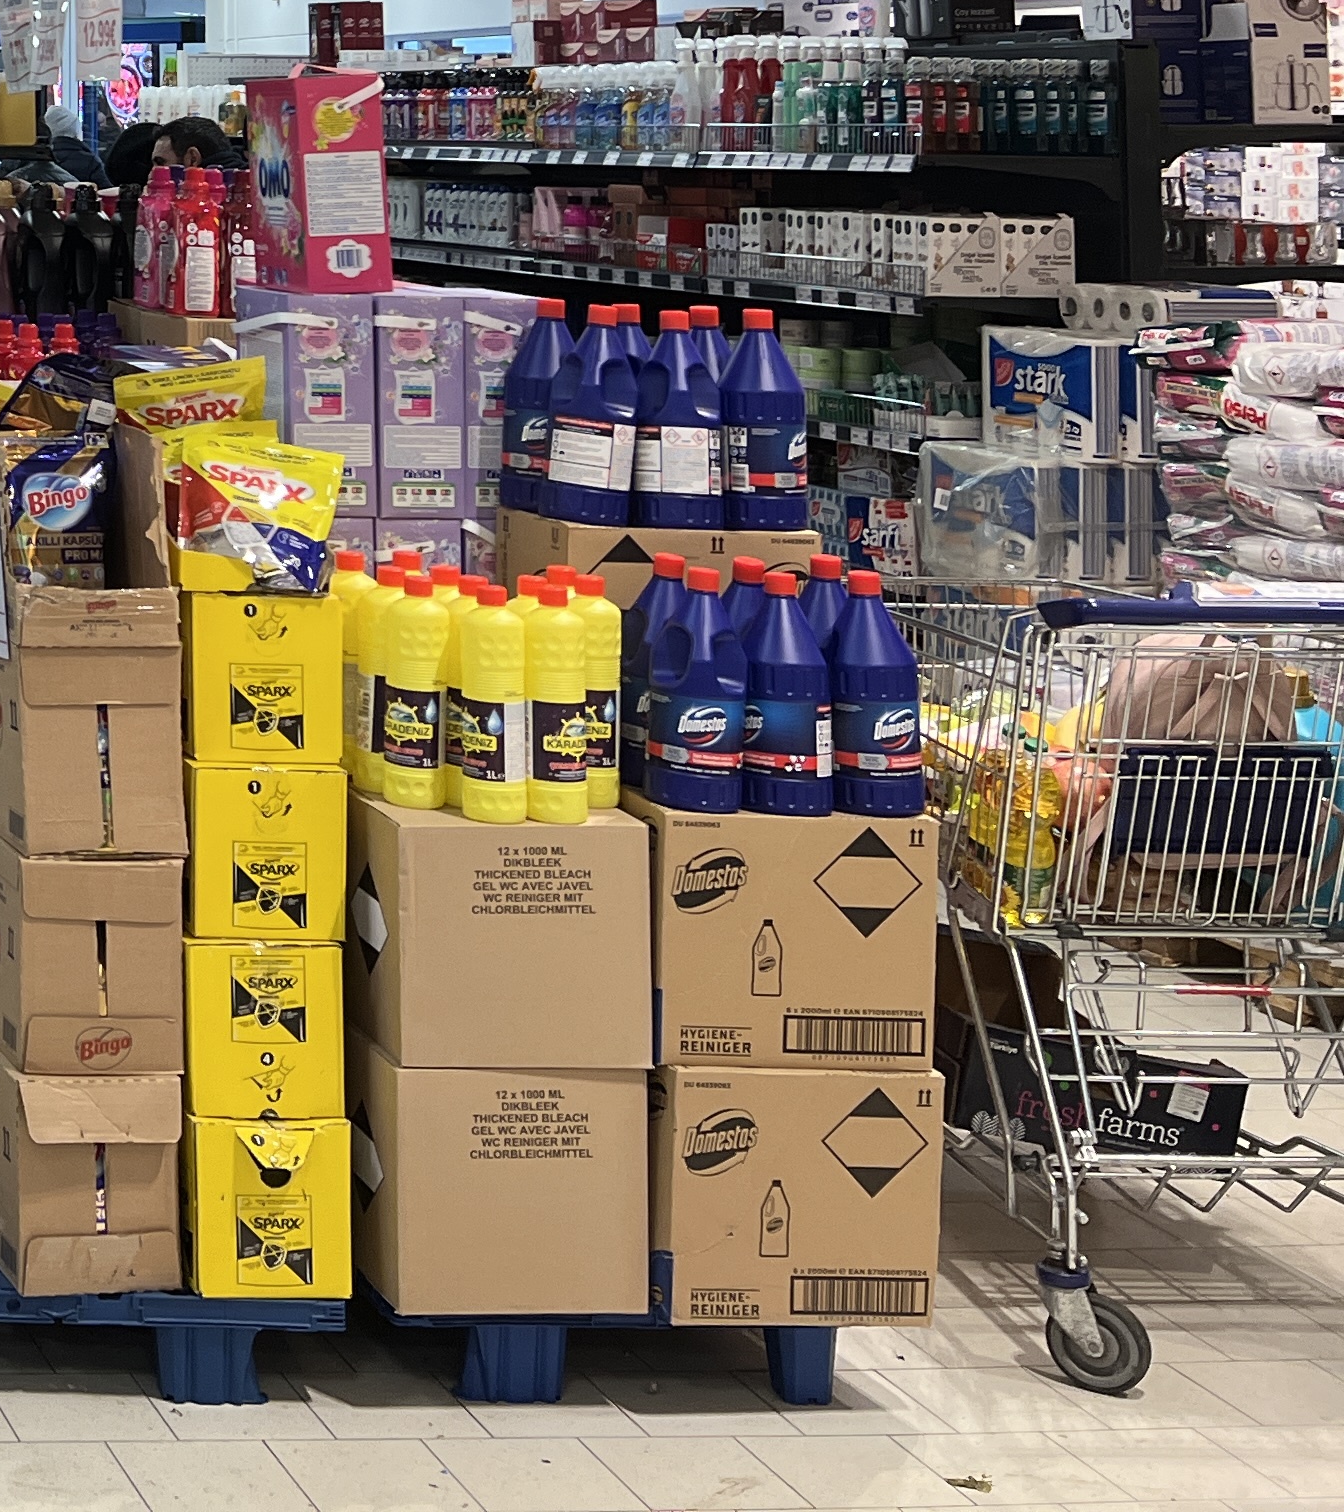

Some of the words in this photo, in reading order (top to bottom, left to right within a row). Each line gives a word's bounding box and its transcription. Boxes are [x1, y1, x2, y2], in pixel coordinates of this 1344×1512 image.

[1014, 365, 1069, 396] stark
[145, 398, 240, 426] SPARX
[27, 484, 88, 518] Bingo
[65, 549, 89, 561] PRO
[246, 684, 293, 697] SPARX
[677, 713, 728, 734] Domestos
[874, 715, 917, 741] Domestos
[485, 770, 497, 779] 1L
[497, 846, 510, 856] 12
[513, 848, 520, 856] x
[523, 846, 548, 856] 1000
[550, 846, 567, 856] ML
[503, 858, 562, 867] DIKBLEEK
[249, 862, 297, 877] SPARX
[474, 870, 541, 879] THICKENED
[544, 869, 592, 879] BLEACH
[473, 881, 497, 891] GEL
[499, 881, 519, 891] WC
[521, 881, 554, 891] AVEC
[556, 881, 593, 891] JAVEL
[671, 863, 750, 897] Domestos
[483, 893, 503, 903] WC
[505, 893, 561, 903] REINIGER
[563, 893, 584, 903] MIT
[471, 904, 597, 915] CHLORBLEICHMITTEL
[247, 975, 295, 991] SPARX
[843, 1008, 860, 1016] EAN
[680, 1027, 743, 1040] HYGIENE-
[78, 1032, 133, 1061] Bingo
[680, 1040, 751, 1053] REINIGER
[495, 1090, 508, 1100] 12
[510, 1091, 517, 1099] x
[520, 1090, 545, 1099] 1000
[548, 1089, 565, 1099] ML
[501, 1101, 560, 1111] DIKBLEEK
[472, 1113, 539, 1123] THICKENED
[541, 1113, 589, 1123] BLEACH
[471, 1126, 495, 1136] GEL
[498, 1126, 516, 1135] WC
[519, 1125, 551, 1135] AVEC
[554, 1125, 591, 1135] JAVEL
[1096, 1108, 1180, 1148] farms
[481, 1138, 501, 1147] WC
[503, 1137, 559, 1147] REINIGER
[561, 1137, 581, 1146] MIT
[682, 1120, 759, 1158] Domestos
[469, 1149, 594, 1160] CHLORBLEICHMITTEL
[253, 1214, 303, 1231] SPARX
[848, 1268, 865, 1276] EAN
[690, 1291, 751, 1303] HYGIENE-
[690, 1304, 760, 1316] REINIGER
